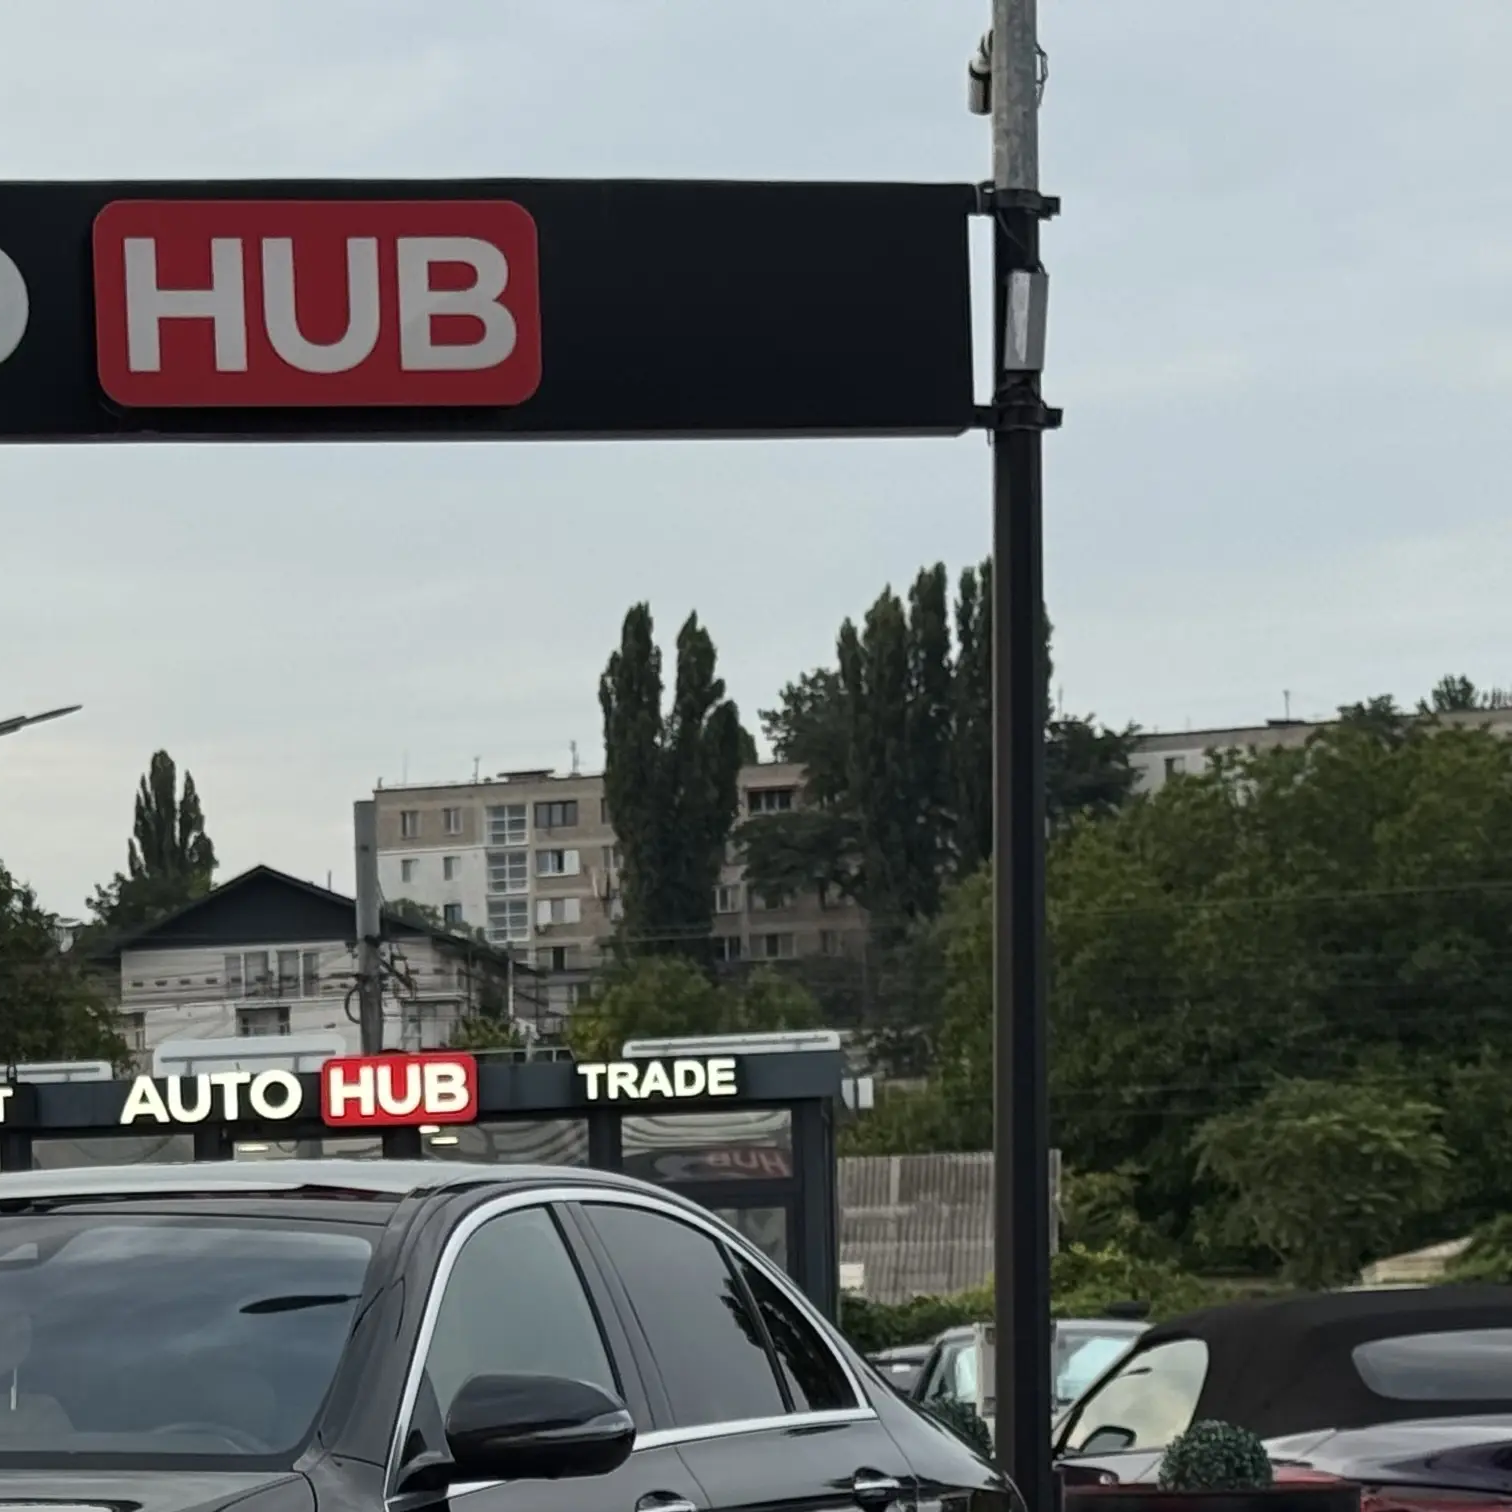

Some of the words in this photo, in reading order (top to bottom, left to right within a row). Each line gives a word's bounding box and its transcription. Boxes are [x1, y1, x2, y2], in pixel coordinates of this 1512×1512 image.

[124, 236, 518, 374] HUB
[120, 1069, 303, 1125] AUTO
[328, 1062, 470, 1118] HUB
[577, 1056, 738, 1101] TRADE
